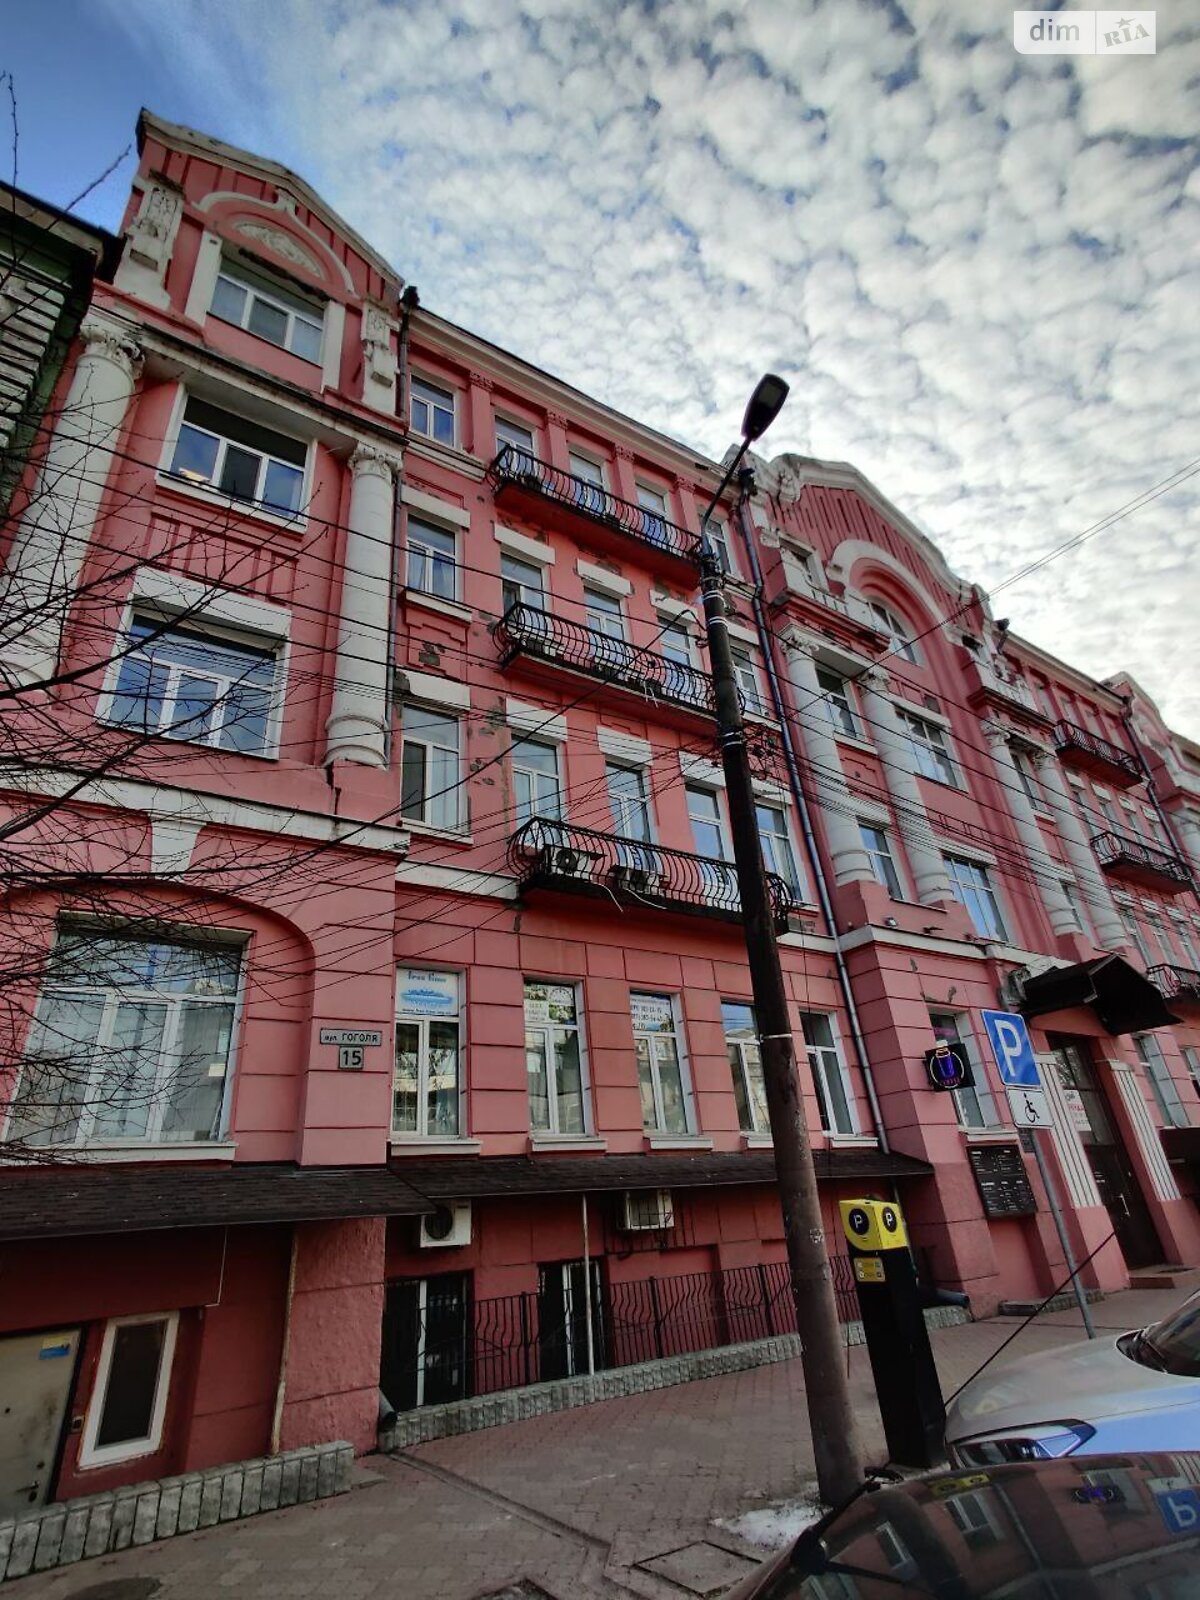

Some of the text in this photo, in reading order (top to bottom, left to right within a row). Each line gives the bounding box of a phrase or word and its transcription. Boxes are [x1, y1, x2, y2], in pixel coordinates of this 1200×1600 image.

[341, 1032, 378, 1043] ГОГОЛЯ
[994, 1019, 1022, 1077] P
[342, 1050, 361, 1066] 15
[853, 1214, 863, 1229] P
